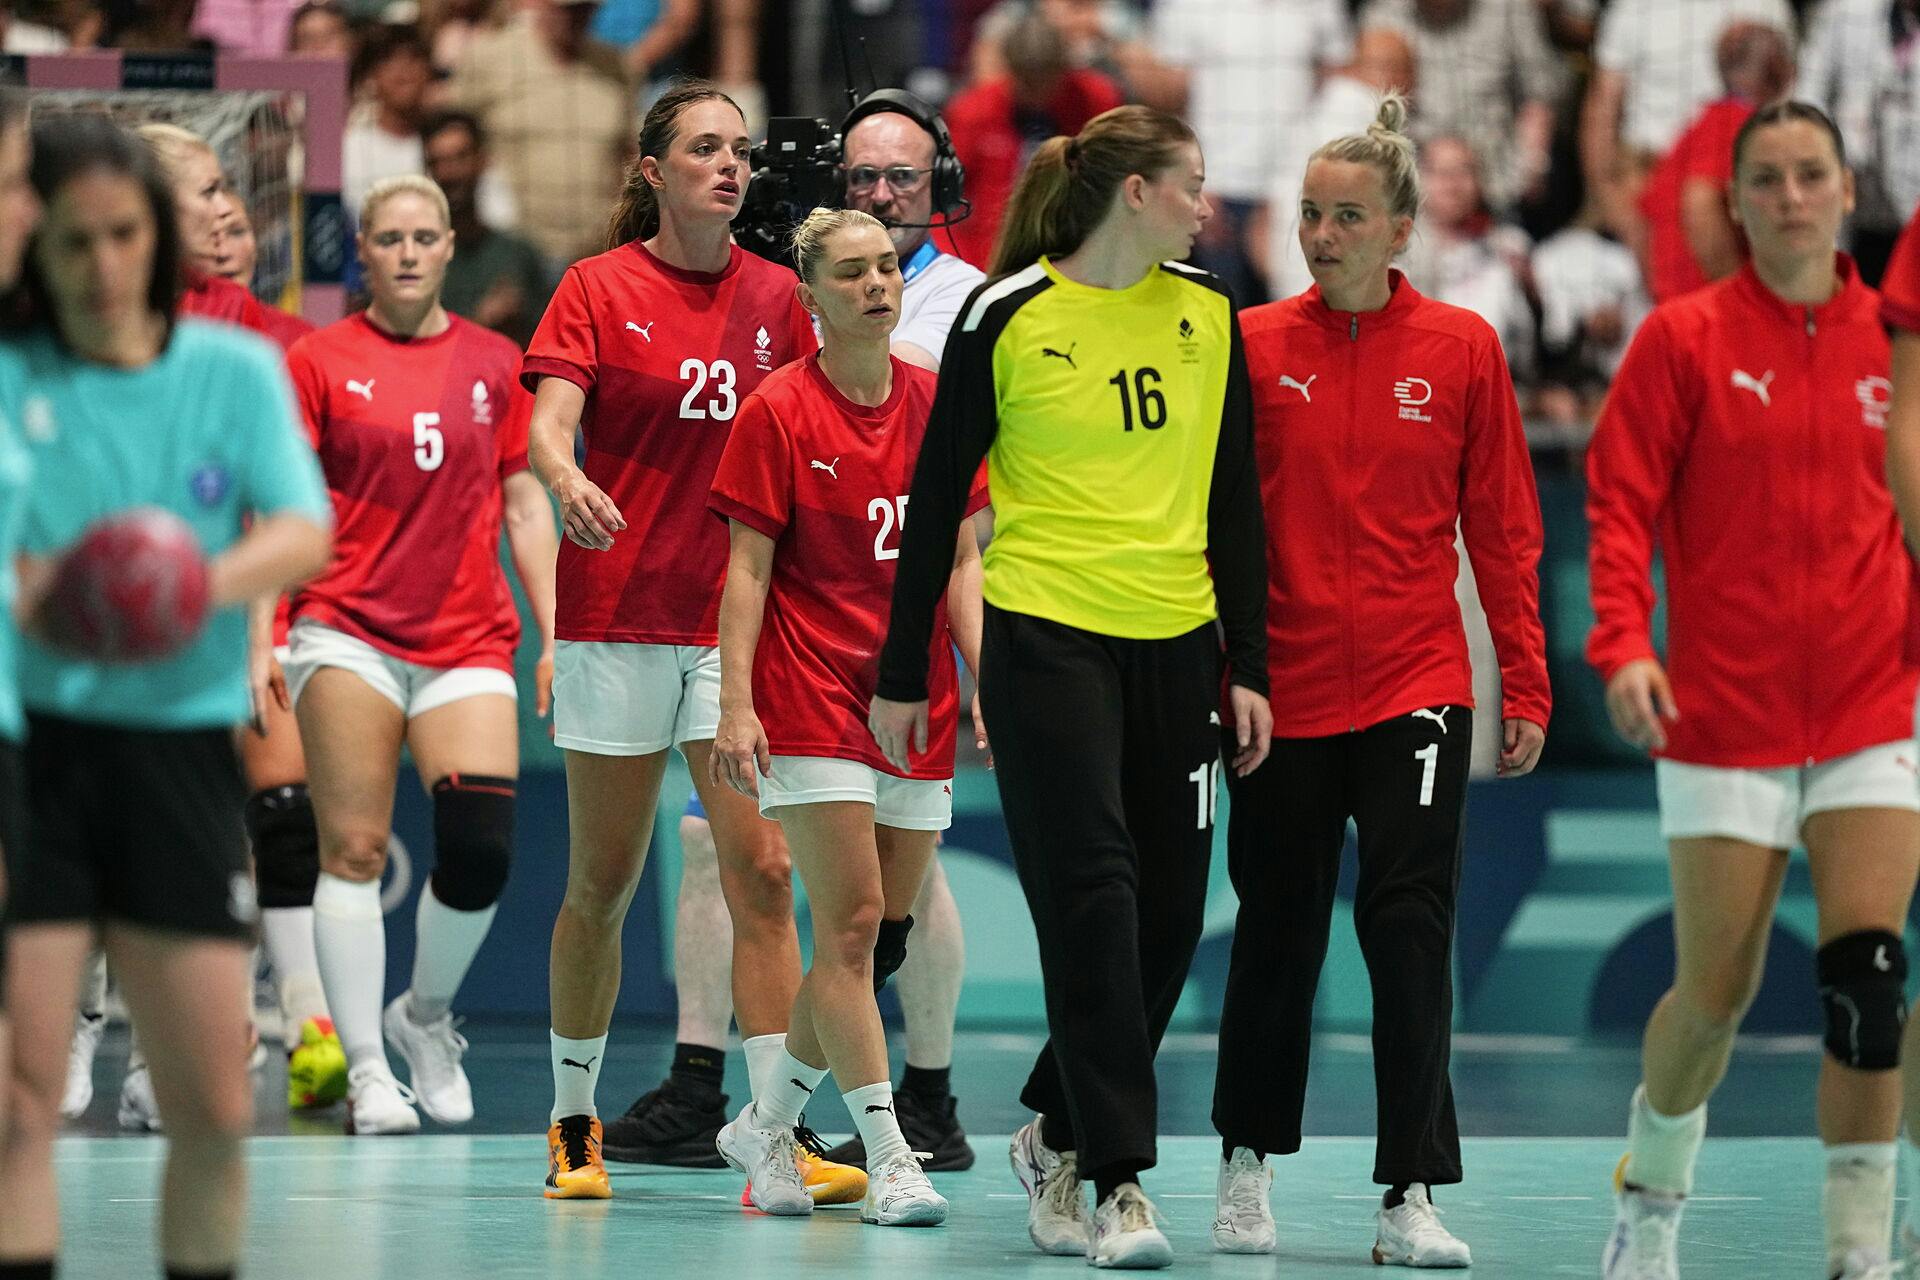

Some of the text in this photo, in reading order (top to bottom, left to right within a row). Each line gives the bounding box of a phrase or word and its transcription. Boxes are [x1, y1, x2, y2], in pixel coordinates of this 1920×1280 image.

[679, 358, 737, 421] 23
[1109, 367, 1167, 431] 16
[413, 412, 444, 471] 5
[1415, 743, 1438, 806] 1
